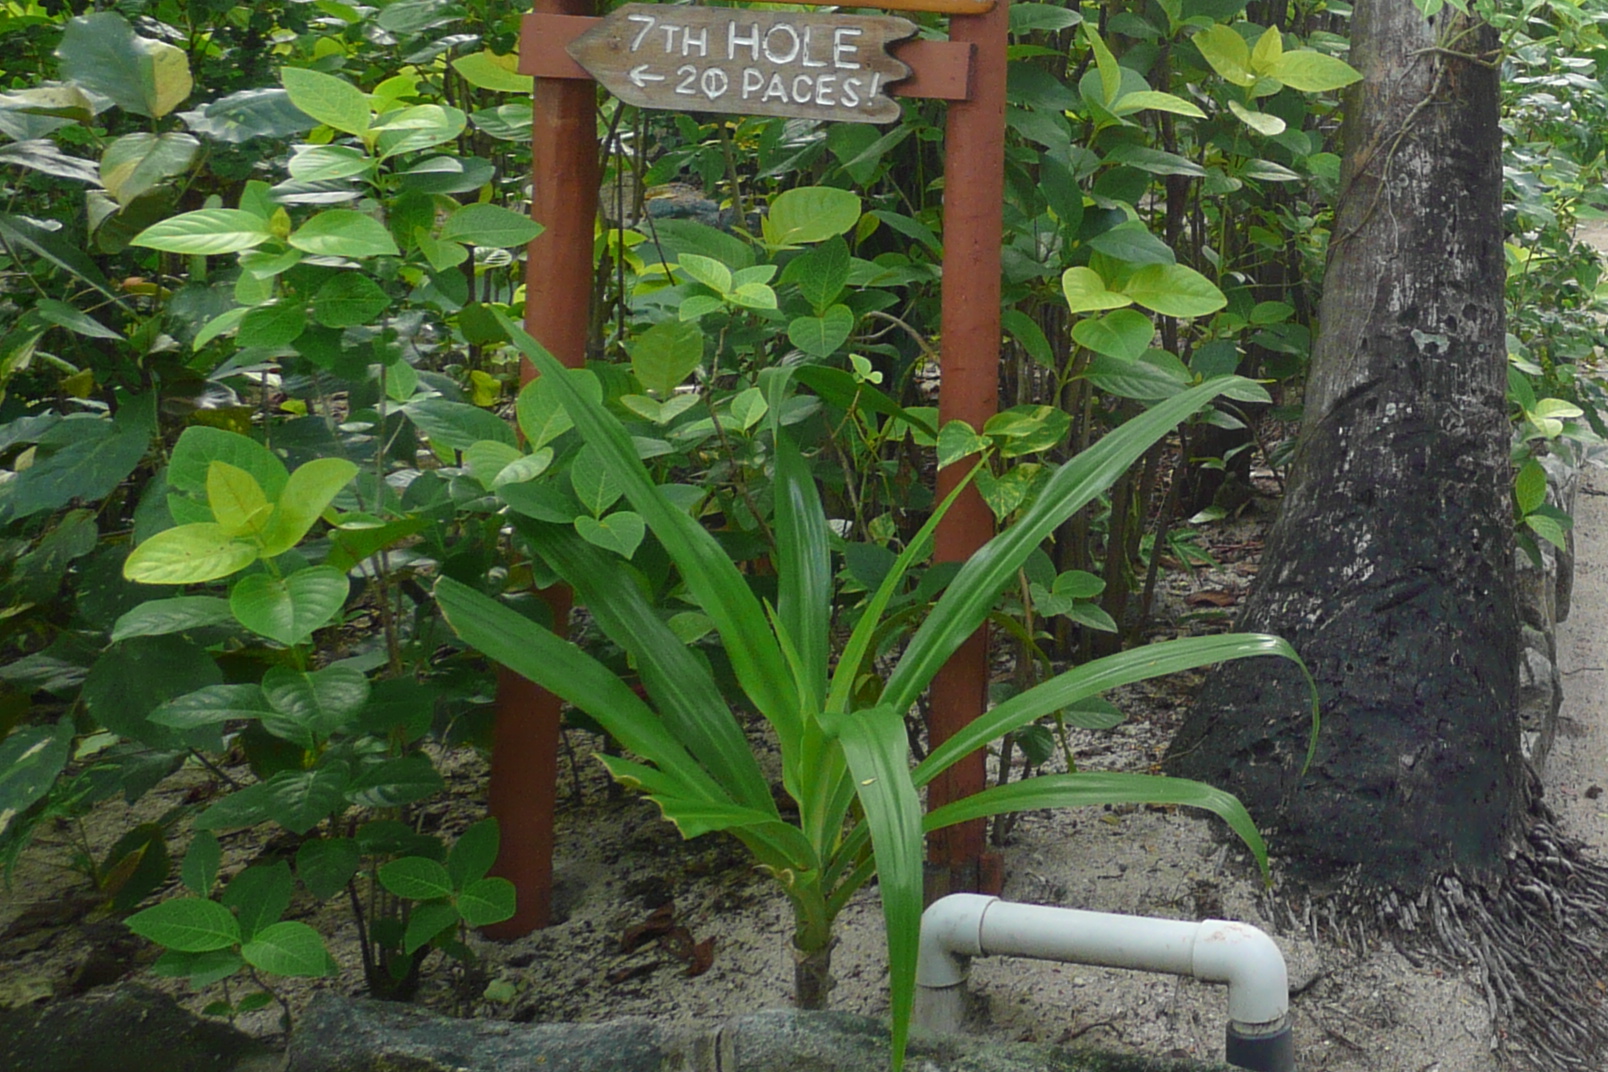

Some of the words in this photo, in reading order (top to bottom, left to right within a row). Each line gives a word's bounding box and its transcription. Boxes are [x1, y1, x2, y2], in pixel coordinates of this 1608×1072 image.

[627, 15, 708, 57] 7TH
[728, 22, 862, 70] HOLE
[741, 72, 882, 108] PACES!
